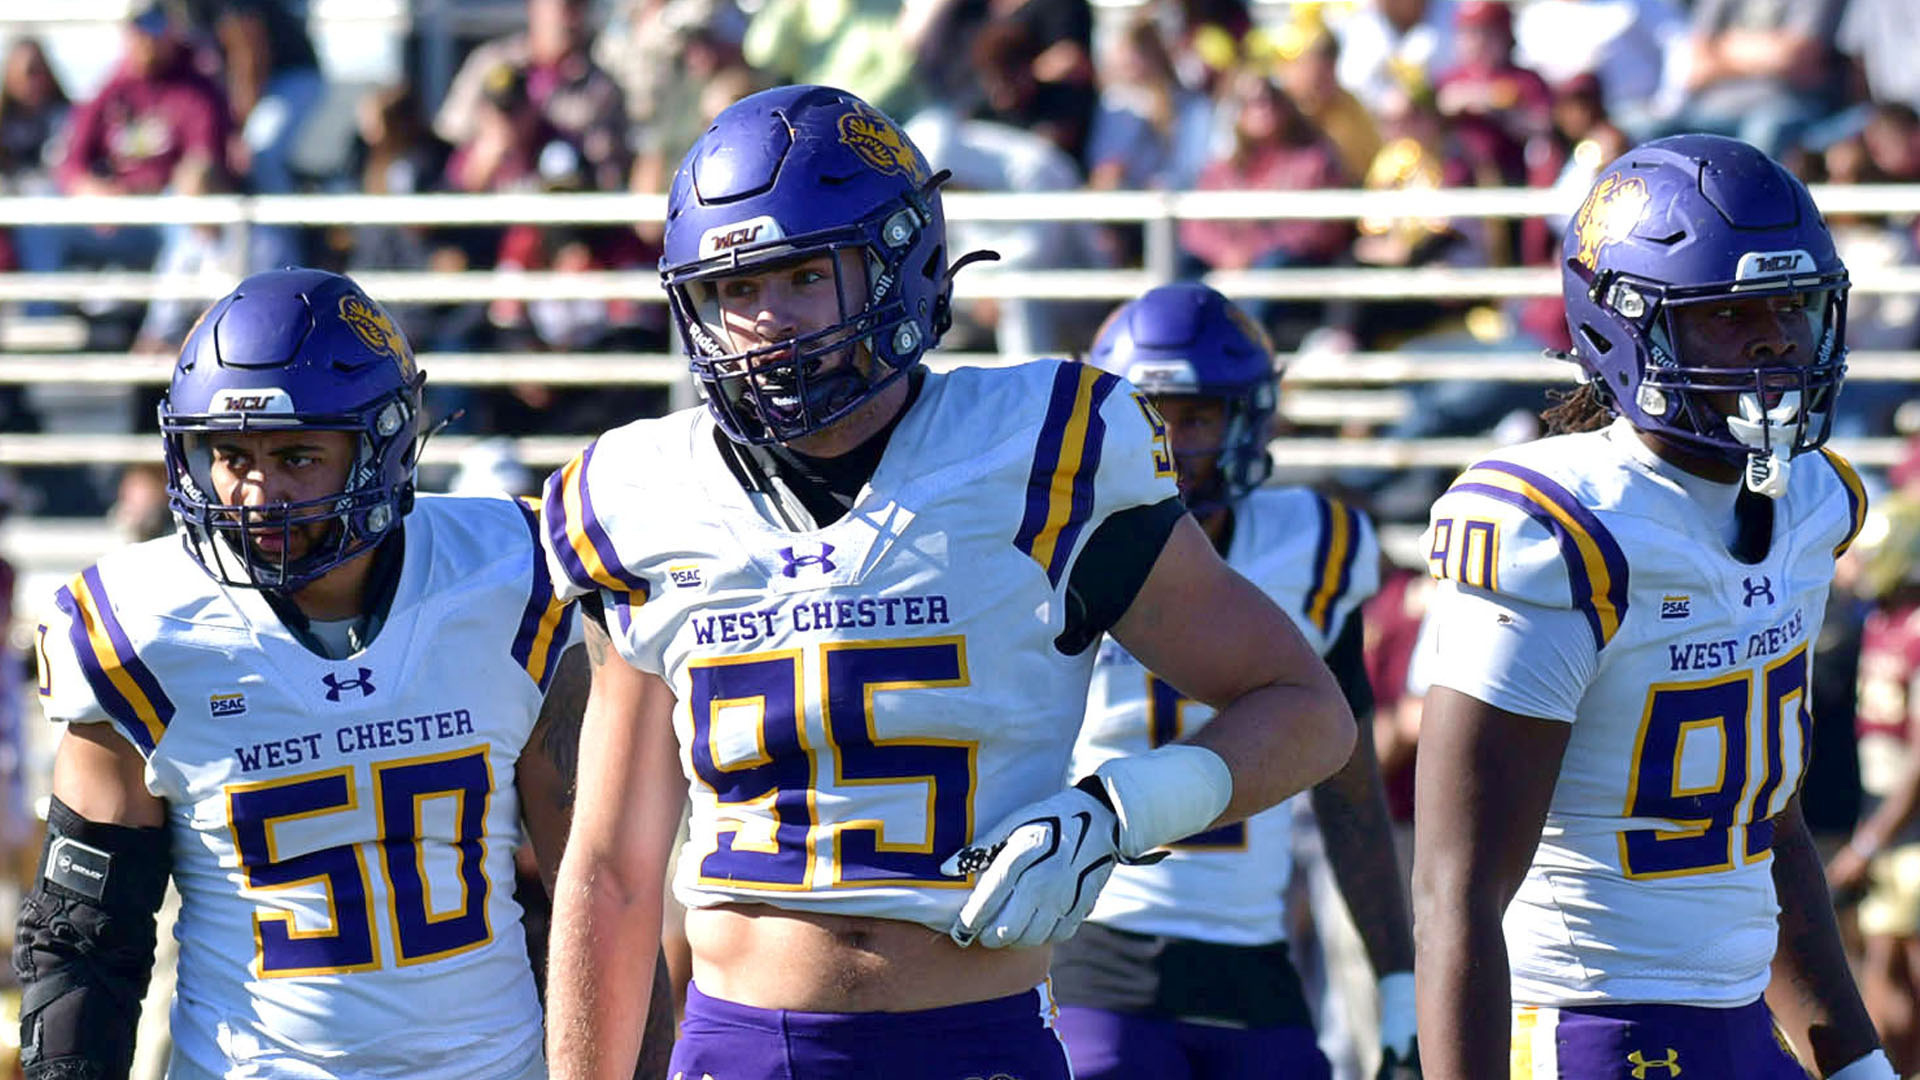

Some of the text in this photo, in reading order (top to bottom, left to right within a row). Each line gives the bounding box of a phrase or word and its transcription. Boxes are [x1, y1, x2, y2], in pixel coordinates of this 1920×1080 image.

[711, 225, 763, 251] WCU
[1755, 254, 1803, 272] WCU
[689, 322, 725, 359] Ridde
[224, 395, 275, 411] WCU
[671, 569, 701, 582] PSAC
[692, 595, 949, 645] WEST CHESTER
[1662, 601, 1690, 612] PSAC
[1669, 640, 1738, 671] WEST
[210, 697, 246, 711] PSAC
[235, 709, 474, 772] WEST CHESTER
[688, 635, 979, 891] 95
[1617, 640, 1812, 880] 90
[223, 743, 495, 980] 50
